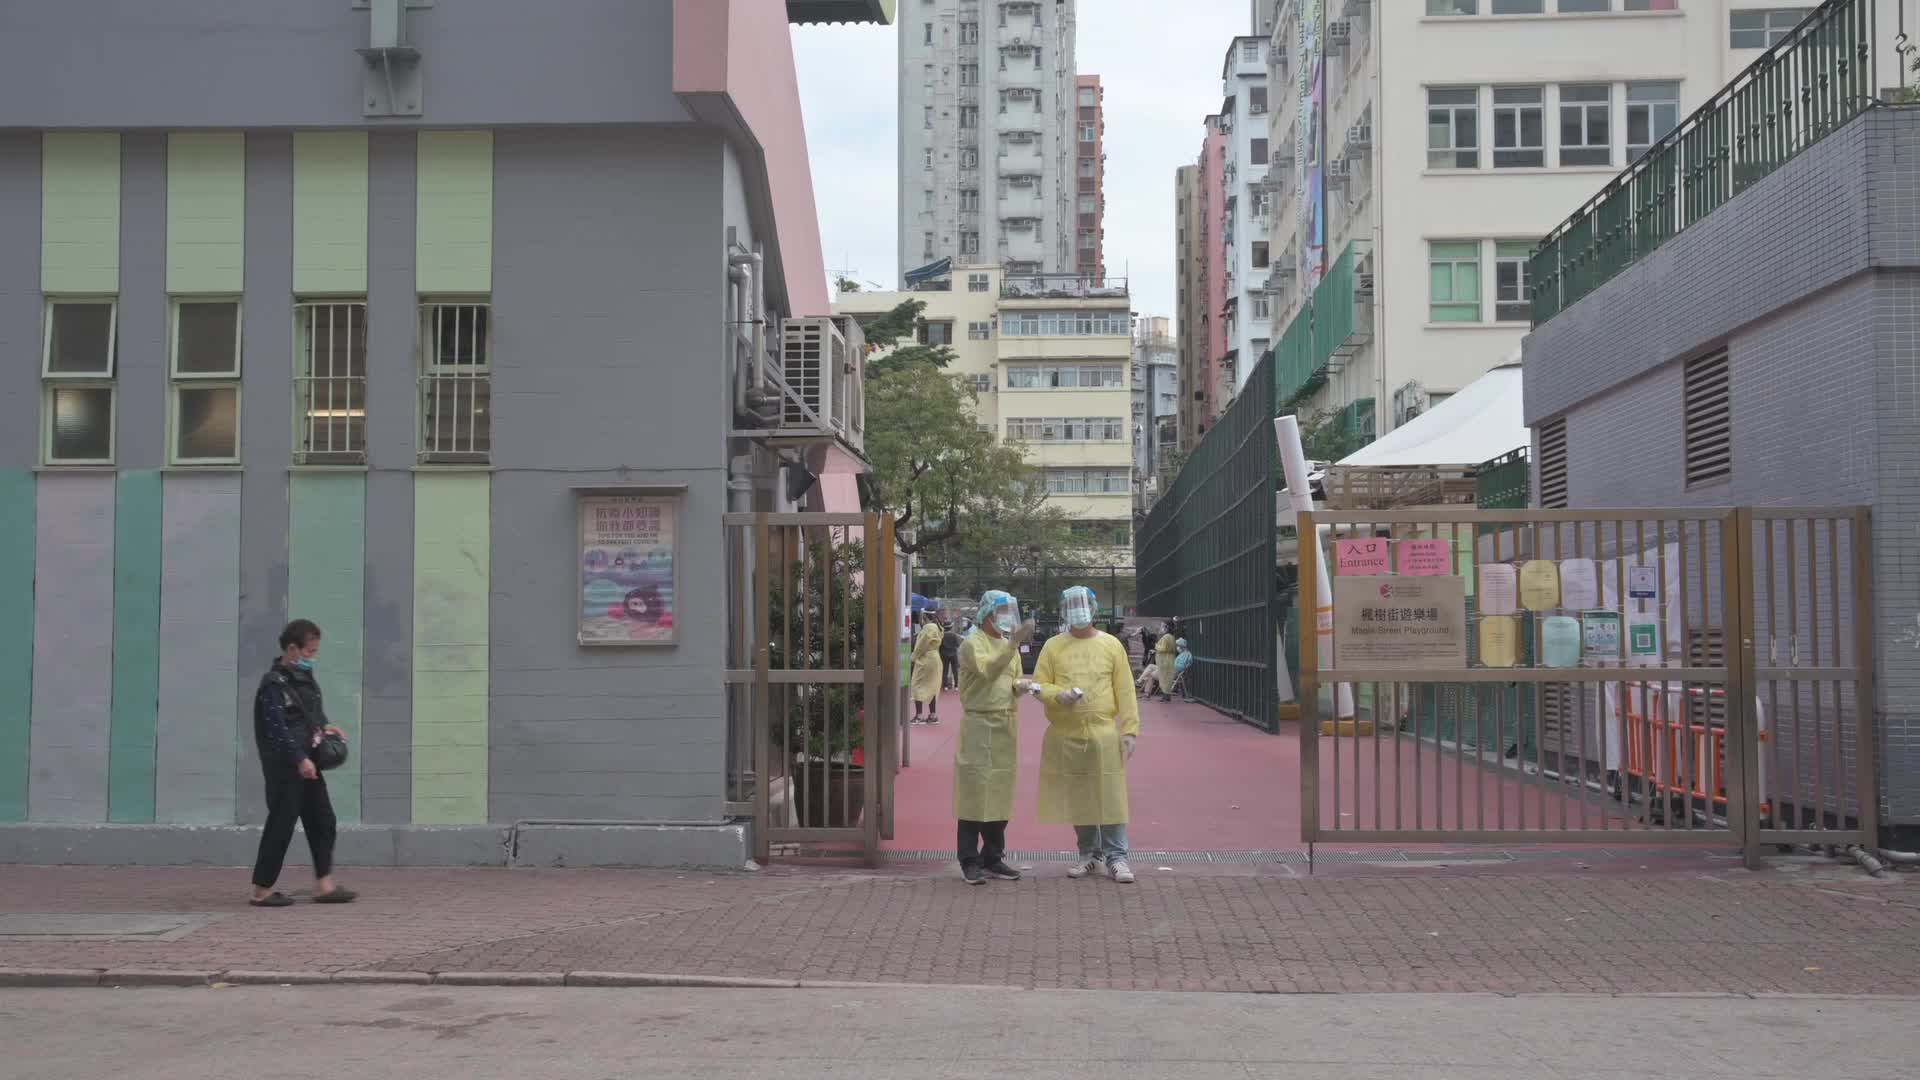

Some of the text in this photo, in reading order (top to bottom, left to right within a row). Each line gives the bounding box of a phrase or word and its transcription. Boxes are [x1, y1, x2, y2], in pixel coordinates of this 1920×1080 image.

[1347, 543, 1377, 554] 入口
[1340, 559, 1384, 568] Entrance
[1361, 607, 1438, 621] 楓樹街遊樂場
[1352, 626, 1449, 635] Maple Street Playground
